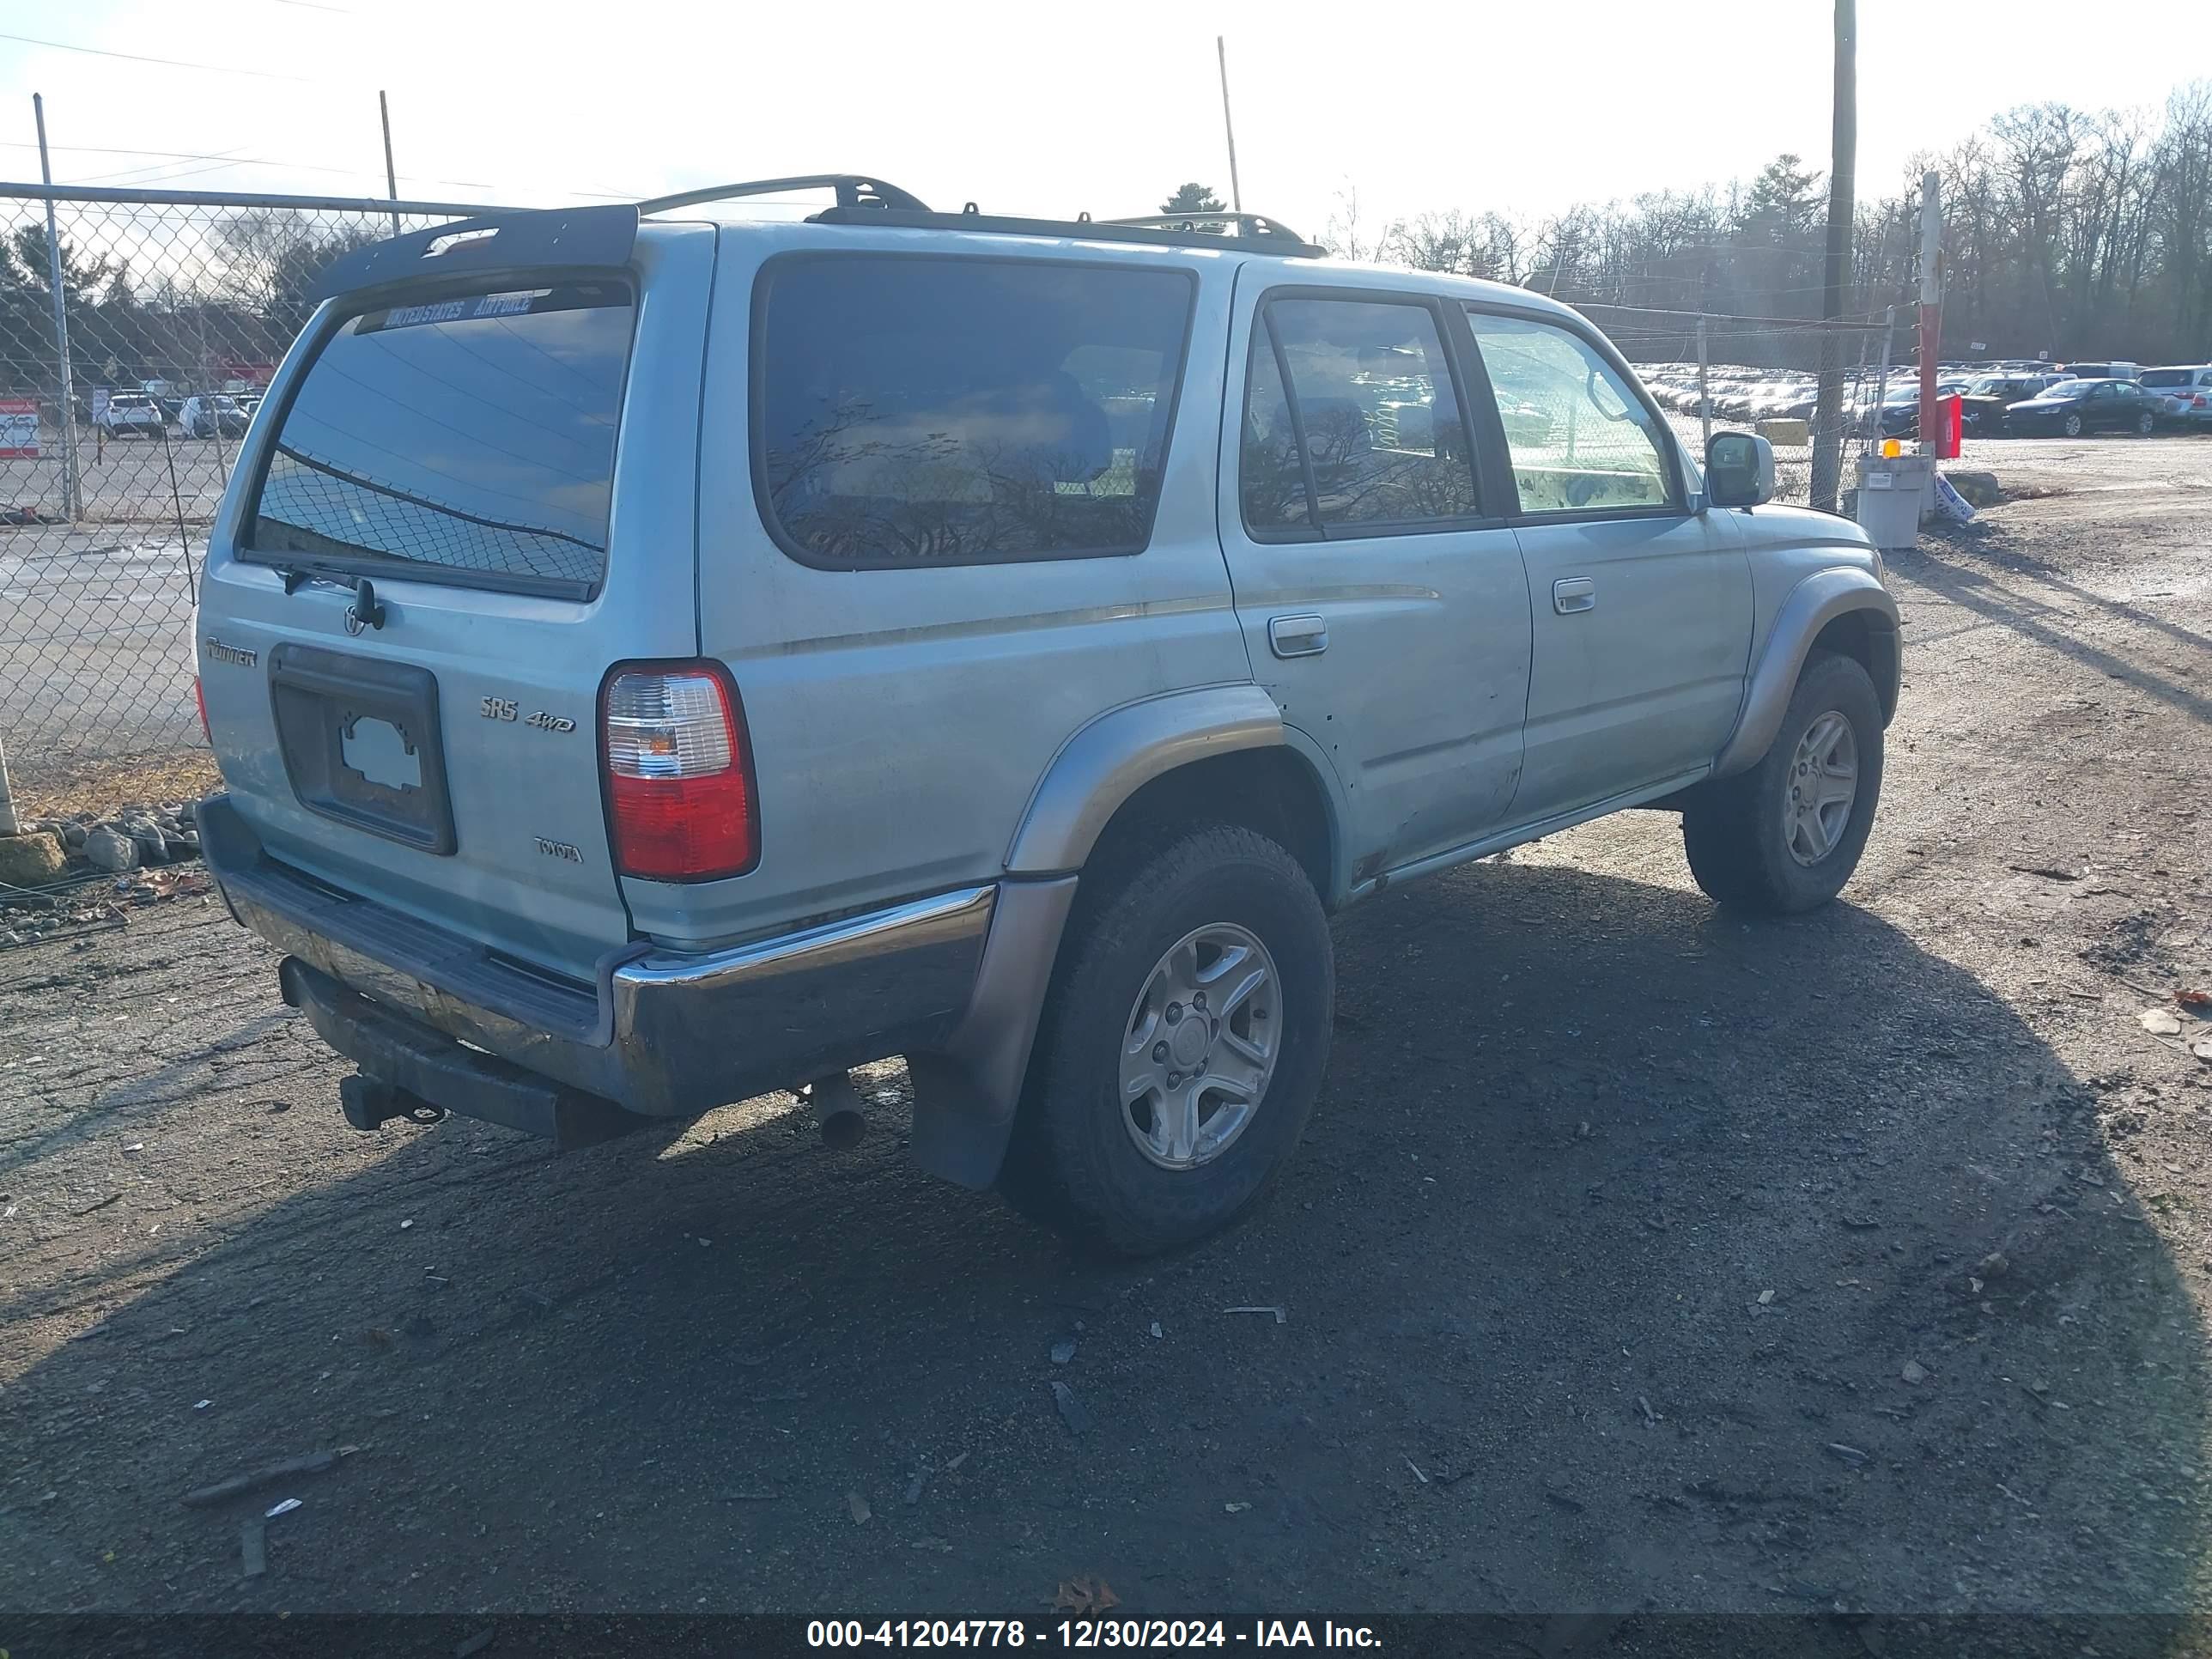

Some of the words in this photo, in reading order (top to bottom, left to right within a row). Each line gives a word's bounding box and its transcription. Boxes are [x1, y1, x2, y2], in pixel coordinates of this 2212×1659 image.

[385, 305, 426, 326] UNITED
[422, 301, 465, 322] STATES
[473, 295, 496, 316] AIR
[493, 293, 534, 313] FORCE
[480, 696, 518, 721] SR5
[525, 711, 576, 732] 4WD
[534, 836, 583, 863] TOYOTA
